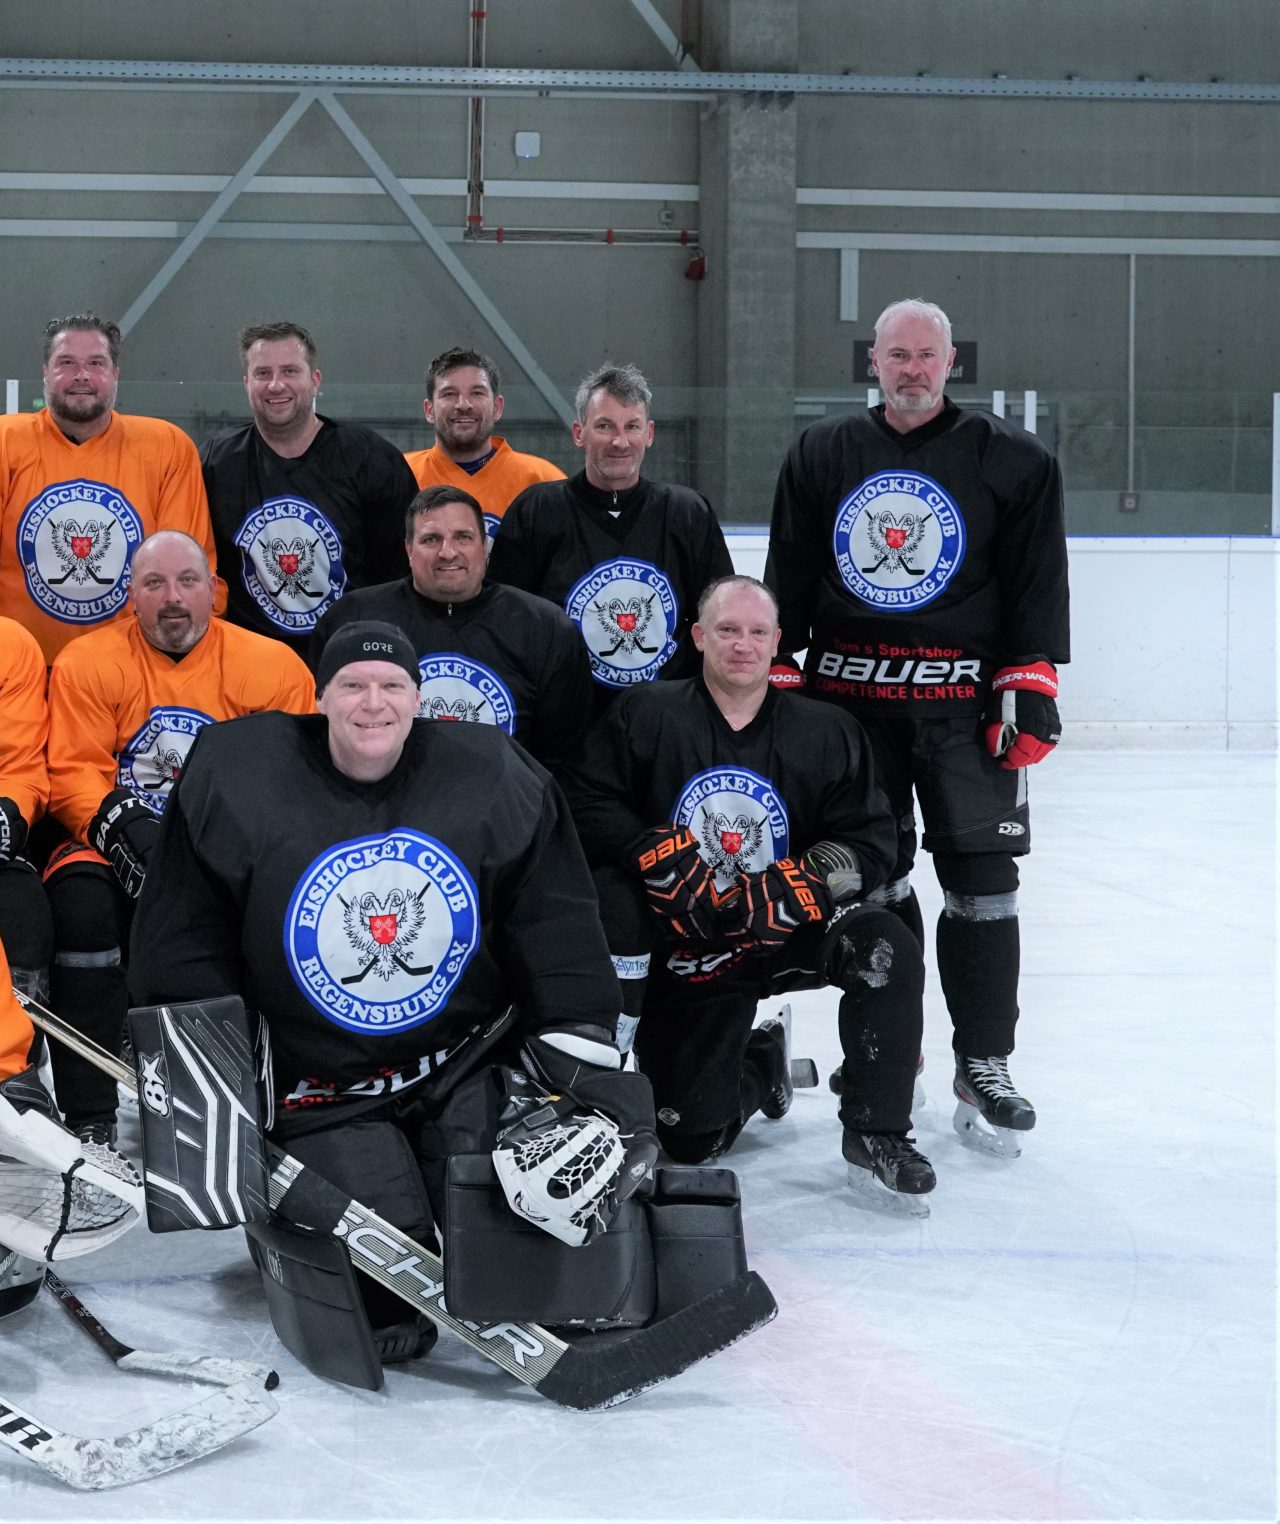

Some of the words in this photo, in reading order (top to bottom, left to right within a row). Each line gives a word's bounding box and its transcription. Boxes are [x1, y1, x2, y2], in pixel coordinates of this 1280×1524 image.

[24, 487, 106, 544] EISHOCKEY
[108, 499, 137, 543] CLUB
[240, 503, 310, 548] ISHOCKEY
[313, 518, 340, 562] CLUB
[839, 478, 925, 535] EISHOCKEY
[926, 492, 956, 537] CLUB
[26, 562, 123, 616] REGENSBURG
[570, 566, 645, 621] EISHOCKEY
[648, 574, 673, 614] CLUB
[838, 552, 935, 603] REGENSBURG
[362, 642, 394, 654] GORE
[878, 643, 963, 660] Sportshop
[478, 679, 509, 725] CLUB
[816, 676, 907, 699] COMPETENCE
[913, 685, 976, 700] CENTER
[298, 840, 412, 930] EISHOCKEY
[417, 851, 470, 913] CLUB
[776, 858, 823, 921] AUER
[300, 956, 447, 1023] REGENSBURG
